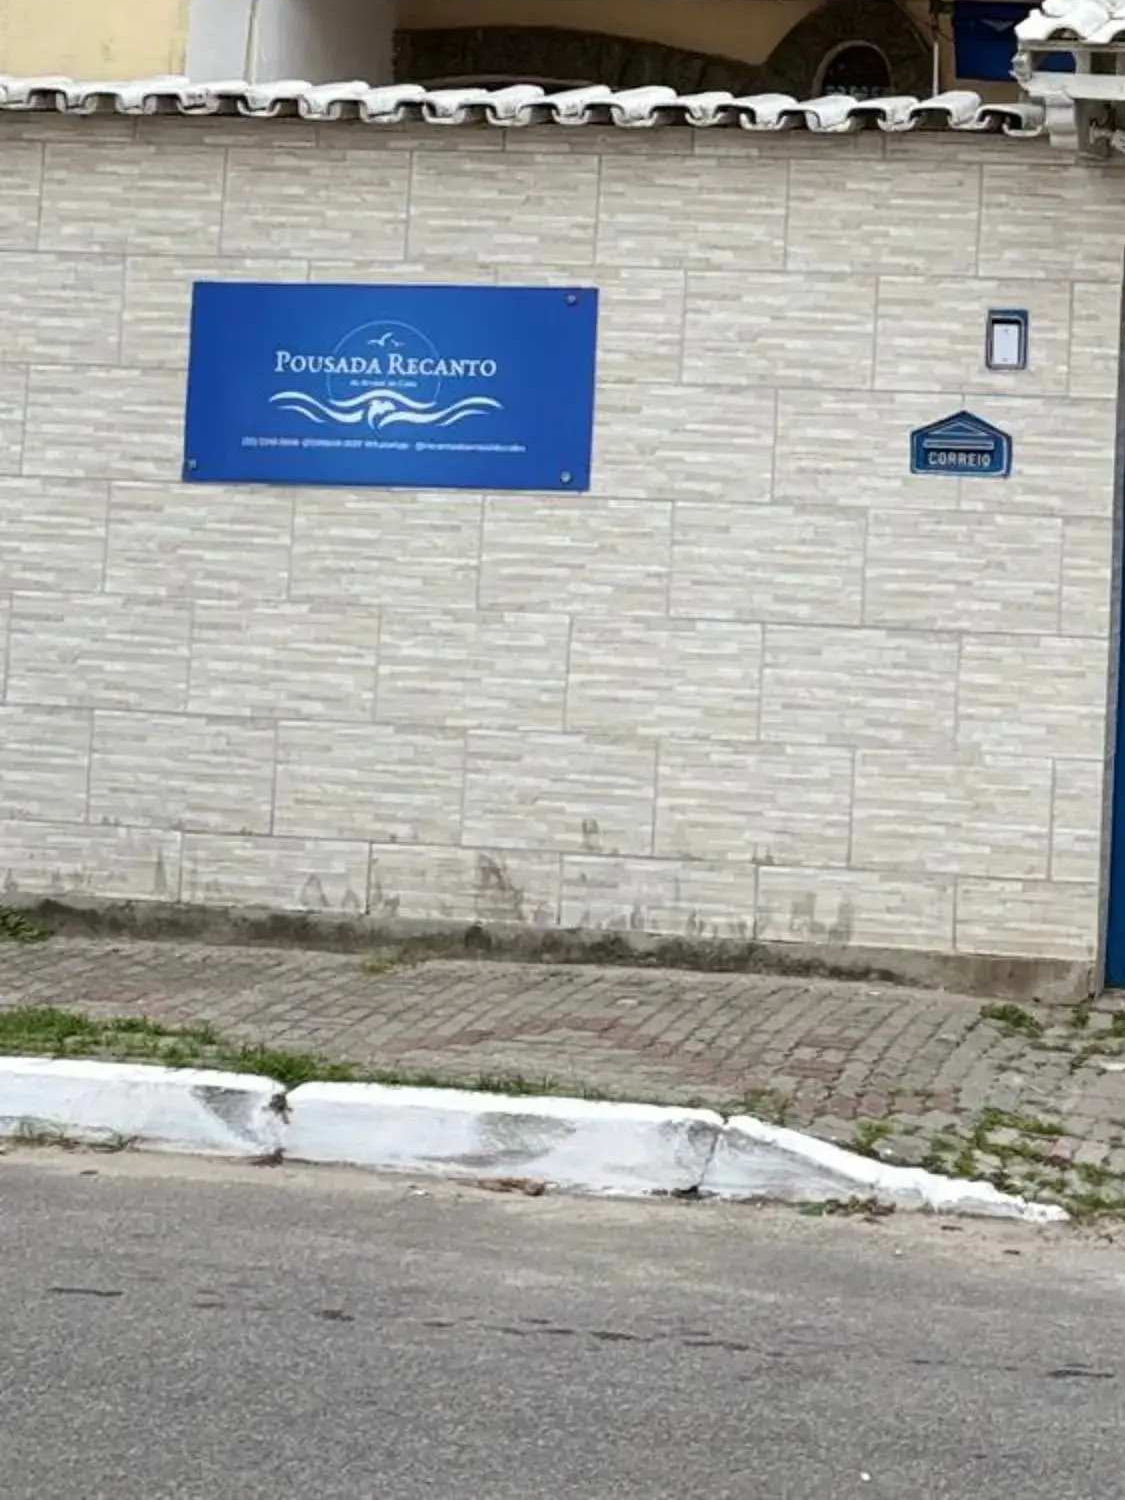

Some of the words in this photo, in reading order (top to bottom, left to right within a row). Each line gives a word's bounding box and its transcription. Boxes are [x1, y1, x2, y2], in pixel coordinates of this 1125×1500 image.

[274, 350, 382, 374] POUSADA
[387, 352, 497, 377] RECANTO
[928, 451, 992, 468] CORREIO
